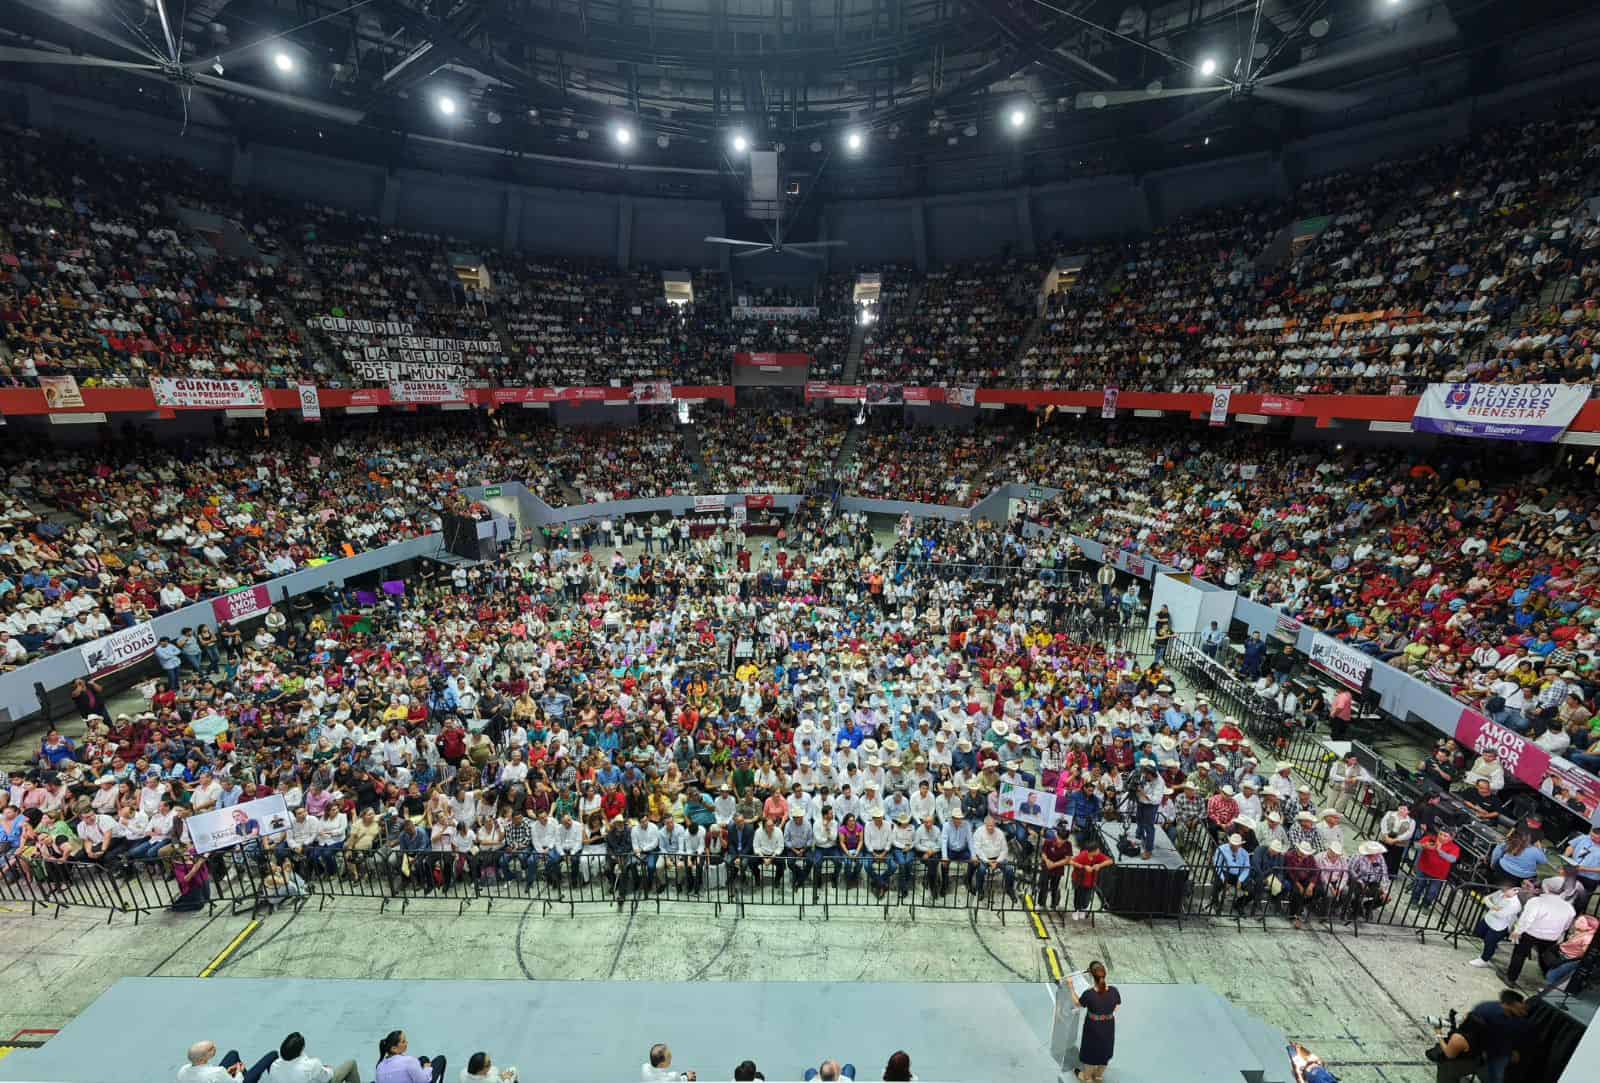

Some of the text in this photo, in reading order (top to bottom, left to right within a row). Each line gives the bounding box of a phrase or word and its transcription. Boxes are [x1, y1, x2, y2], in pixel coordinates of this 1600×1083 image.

[322, 317, 412, 336] CLAUDIA
[401, 336, 501, 353] SHEINBAUM
[366, 346, 464, 363] LA MEJOR
[176, 381, 240, 391] GUAYMAS
[1471, 398, 1551, 410] MUJERES
[1467, 407, 1548, 419] BIENESTAR
[228, 589, 256, 604] AMOR
[230, 597, 257, 611] AMOR
[114, 634, 154, 657] TODAS
[1330, 656, 1366, 682] TODAS
[1480, 722, 1525, 752] AMOR
[1474, 734, 1519, 766] AMOR
